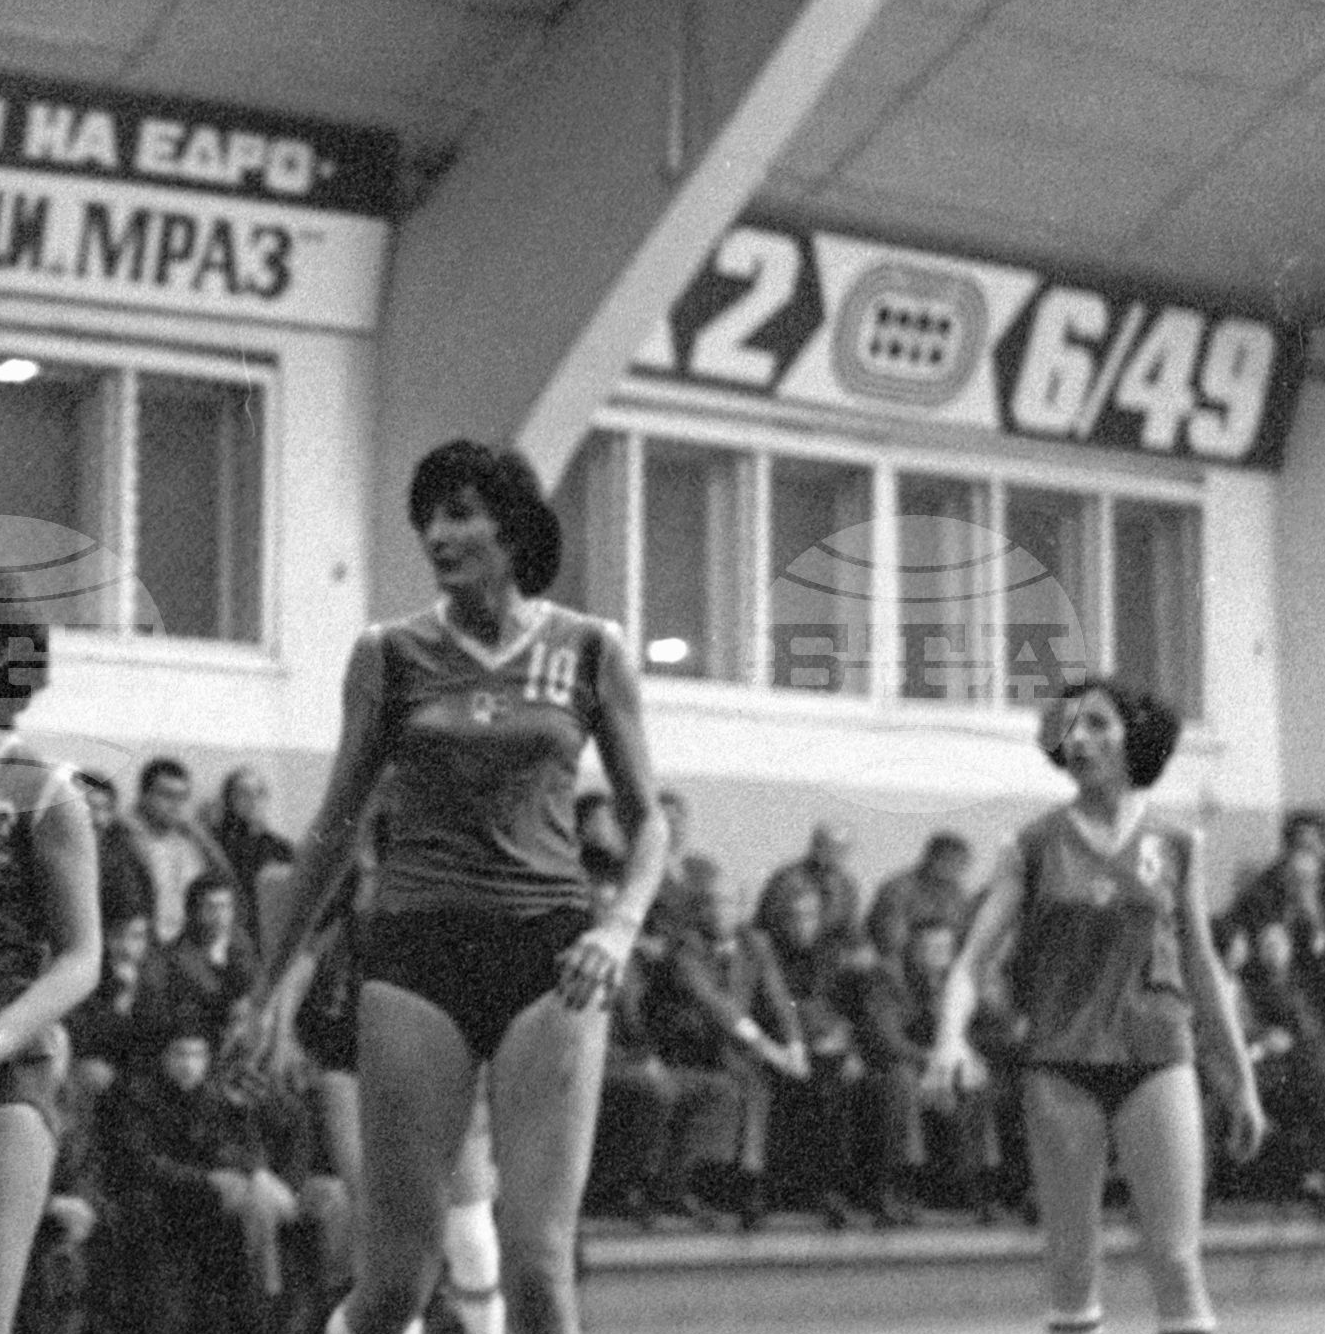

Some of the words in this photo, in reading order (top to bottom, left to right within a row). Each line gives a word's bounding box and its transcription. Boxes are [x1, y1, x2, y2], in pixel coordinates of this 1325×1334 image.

[22, 103, 116, 166] НА
[135, 117, 314, 194] ЕДРО
[690, 227, 799, 385] 2
[1010, 285, 1277, 458] 6/49
[523, 640, 576, 706] 10
